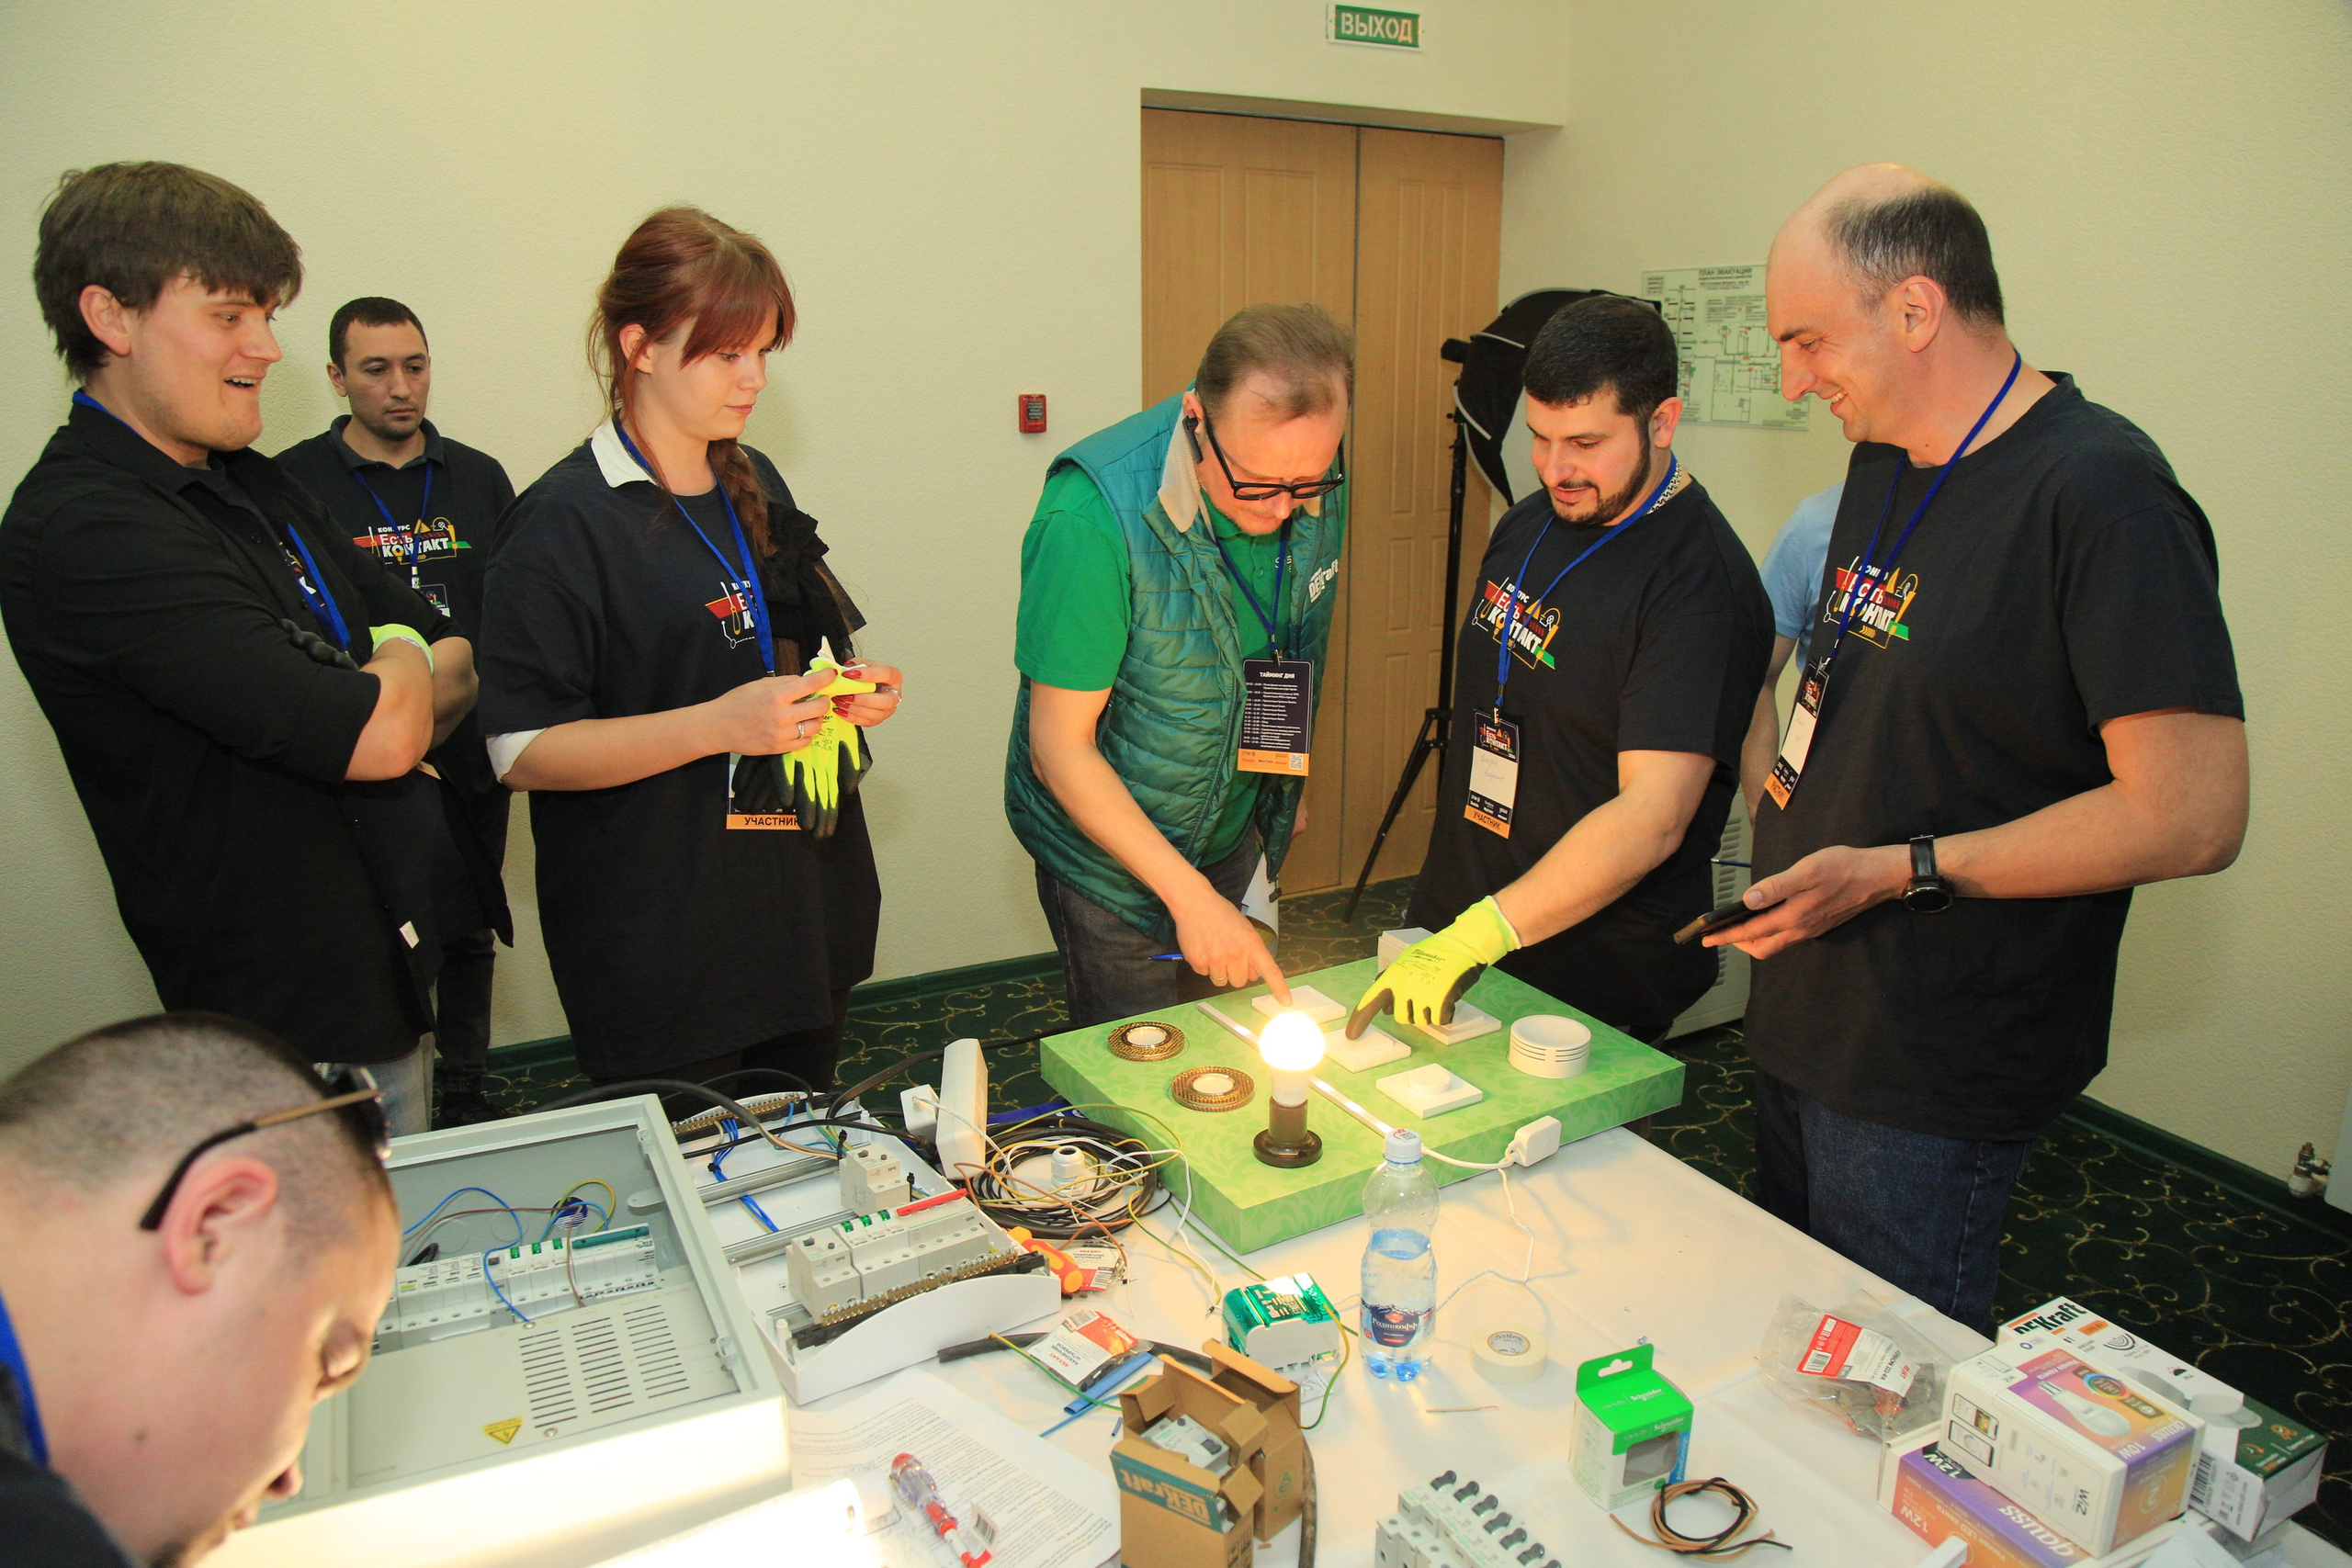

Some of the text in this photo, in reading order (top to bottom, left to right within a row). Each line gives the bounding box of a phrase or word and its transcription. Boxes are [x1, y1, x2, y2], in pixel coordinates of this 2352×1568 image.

[1340, 12, 1413, 43] ВЫХОД
[378, 525, 411, 534] КОНУРС
[1473, 810, 1500, 829] УЧАСТНИК
[1372, 1317, 1418, 1332] Родникофф
[2013, 1302, 2089, 1335] DEKraft
[1049, 1352, 1069, 1368] REXANT
[1630, 1388, 1663, 1402] Schneider
[1654, 1416, 1685, 1432] Schneider
[2118, 1441, 2146, 1460] 10W
[1925, 1452, 1962, 1479] 12W
[1120, 1469, 1212, 1521] DEKraft
[1901, 1506, 1928, 1533] 12W
[1961, 1523, 1979, 1539] LED
[1996, 1504, 2075, 1557] gauss
